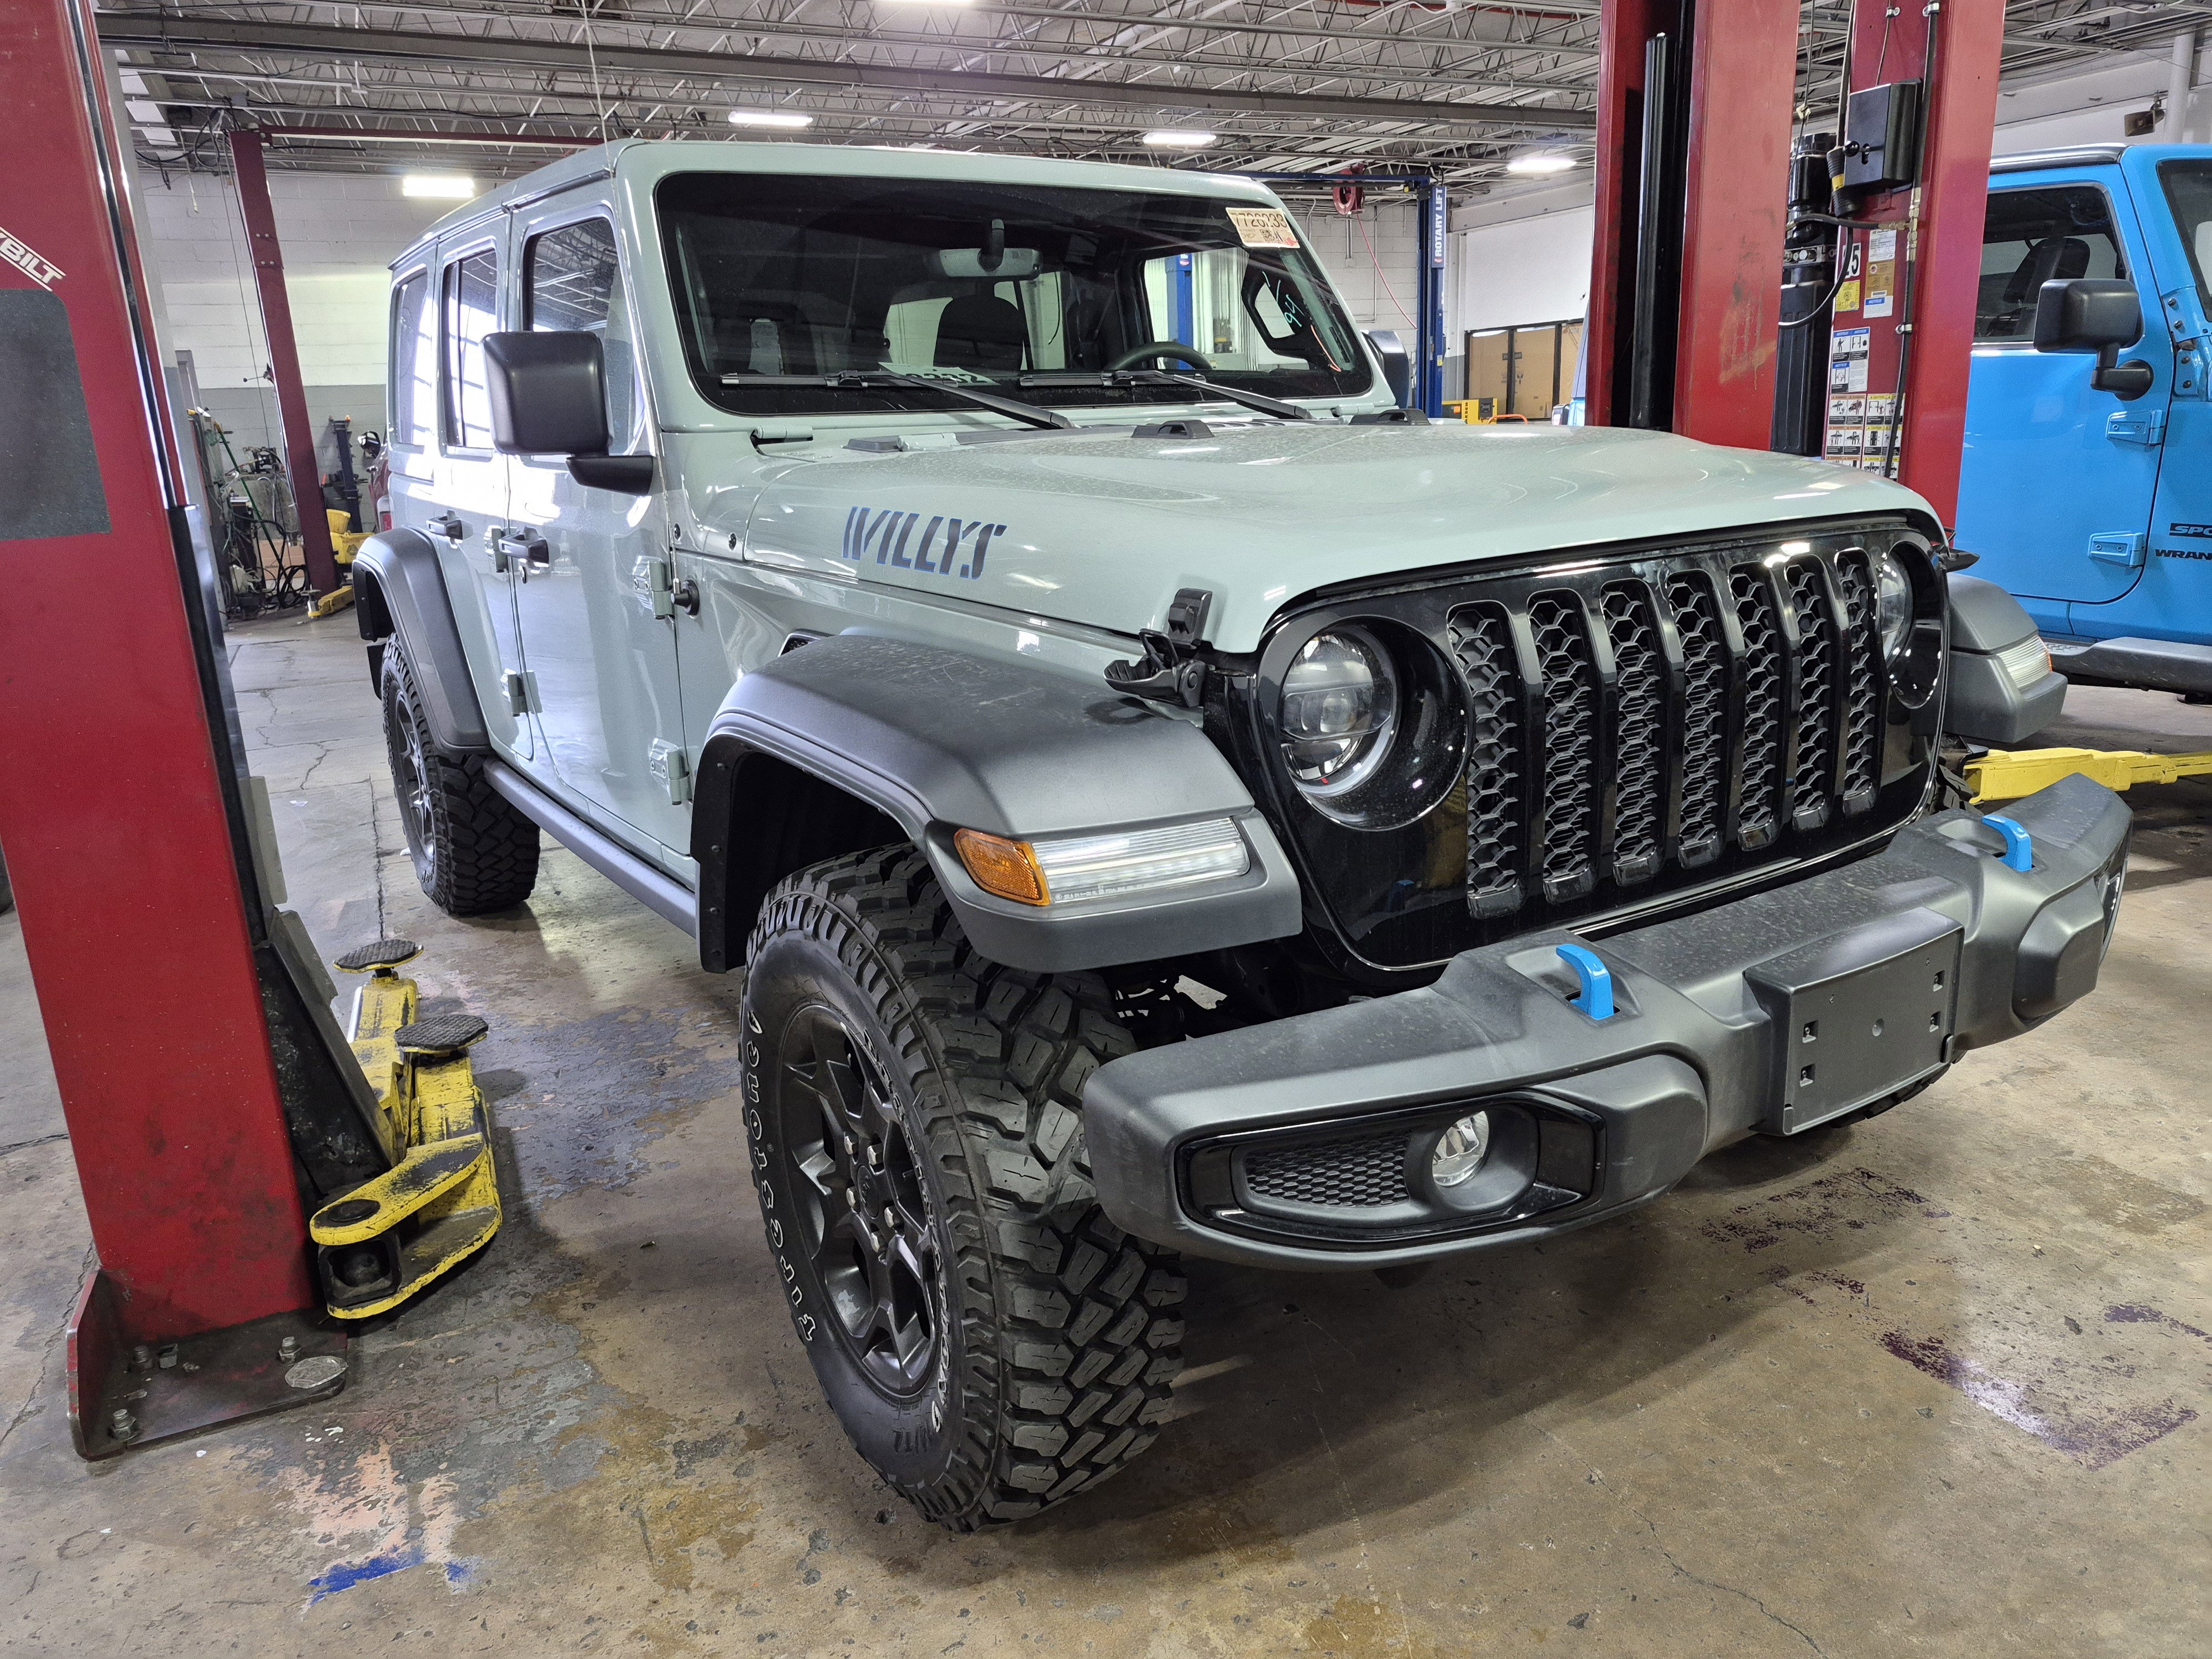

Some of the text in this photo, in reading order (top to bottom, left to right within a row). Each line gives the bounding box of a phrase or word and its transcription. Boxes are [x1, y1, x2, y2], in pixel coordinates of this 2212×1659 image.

[0, 233, 63, 284] BILT
[1434, 213, 1443, 257] ROTARY
[1843, 244, 1860, 276] 5
[842, 506, 1008, 580] WILLYS
